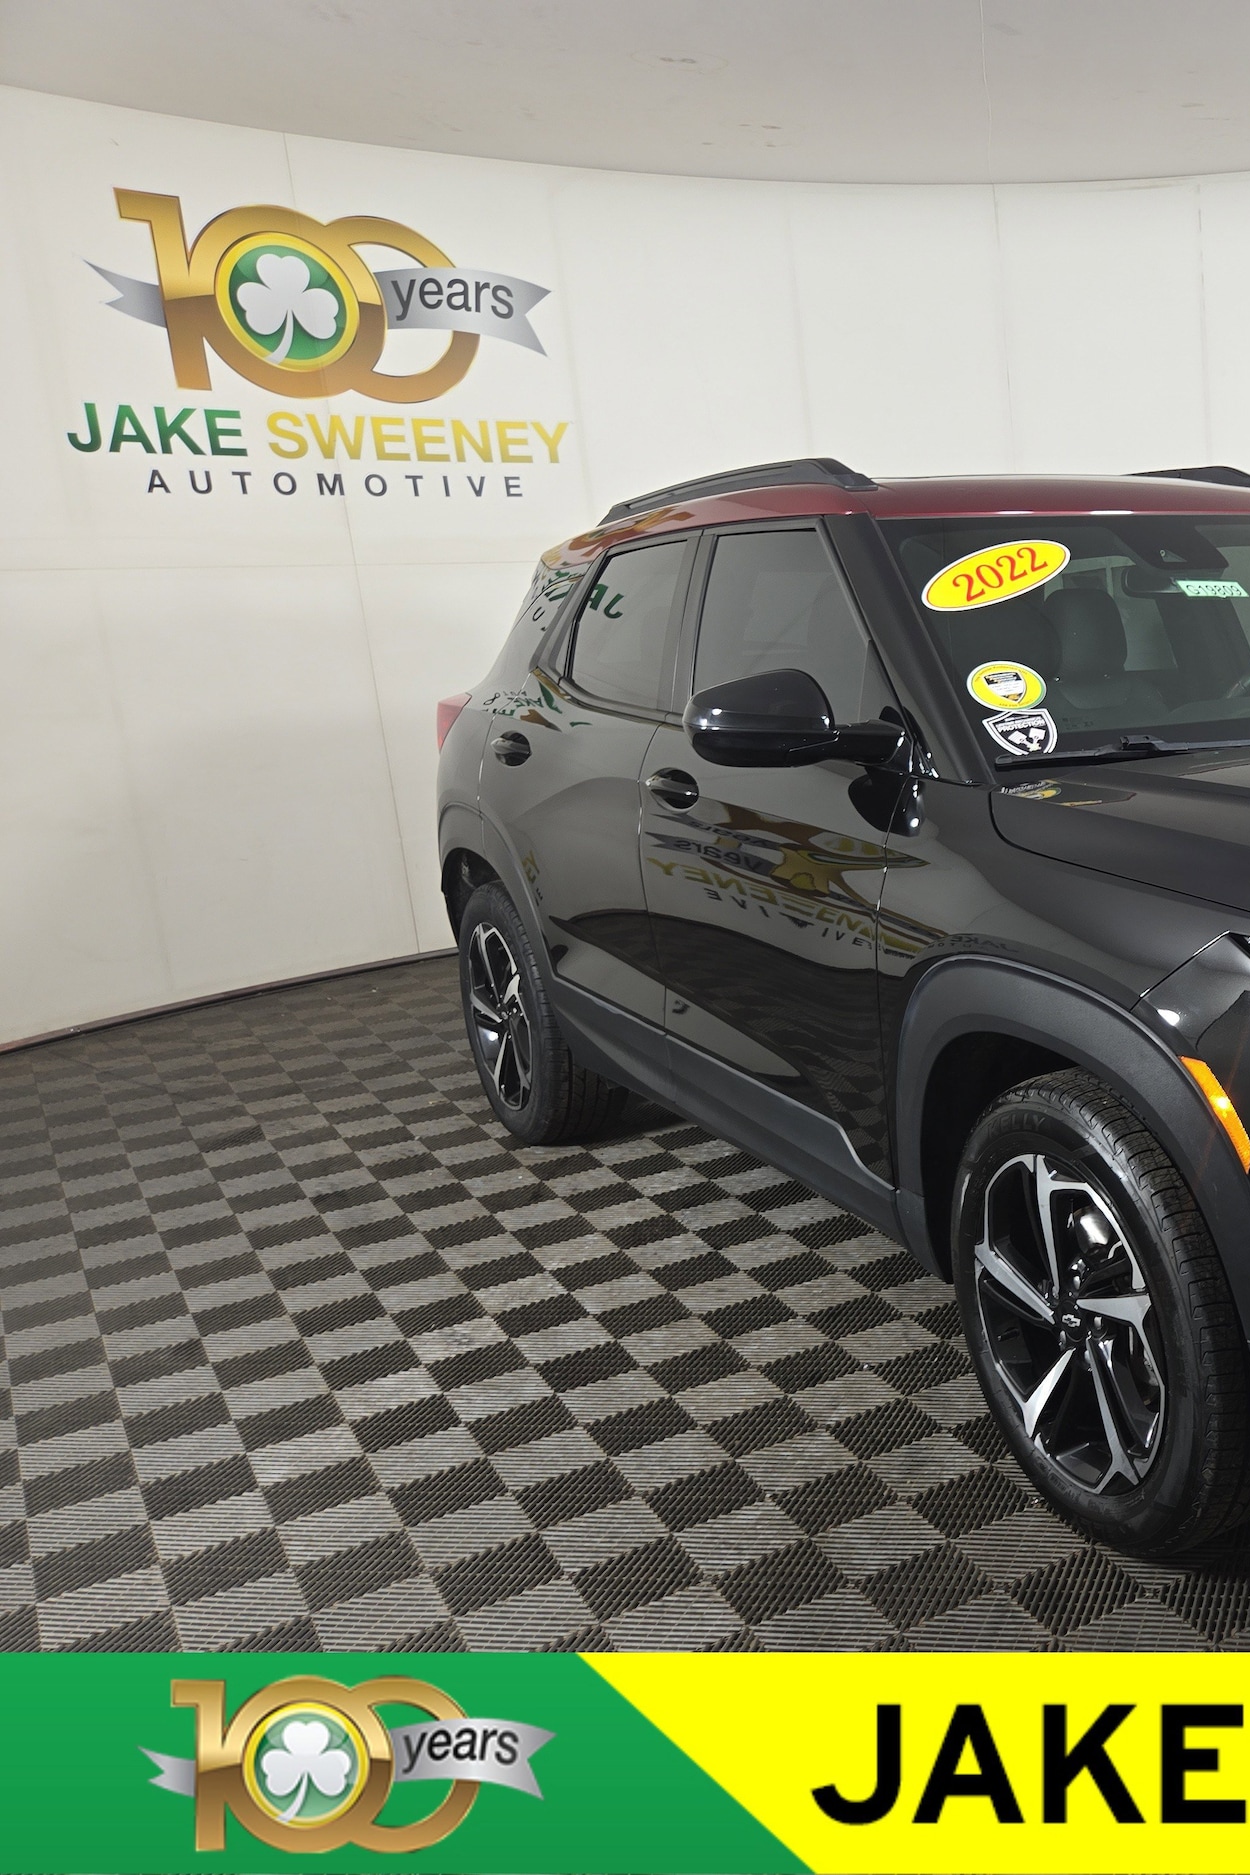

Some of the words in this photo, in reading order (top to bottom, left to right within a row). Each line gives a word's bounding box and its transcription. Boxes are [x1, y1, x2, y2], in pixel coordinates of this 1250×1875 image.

[391, 276, 514, 321] years
[67, 402, 248, 456] JAKE
[267, 411, 569, 465] SWEENEY
[147, 468, 524, 498] AUTOMOTIVE
[953, 547, 1048, 602] 2022
